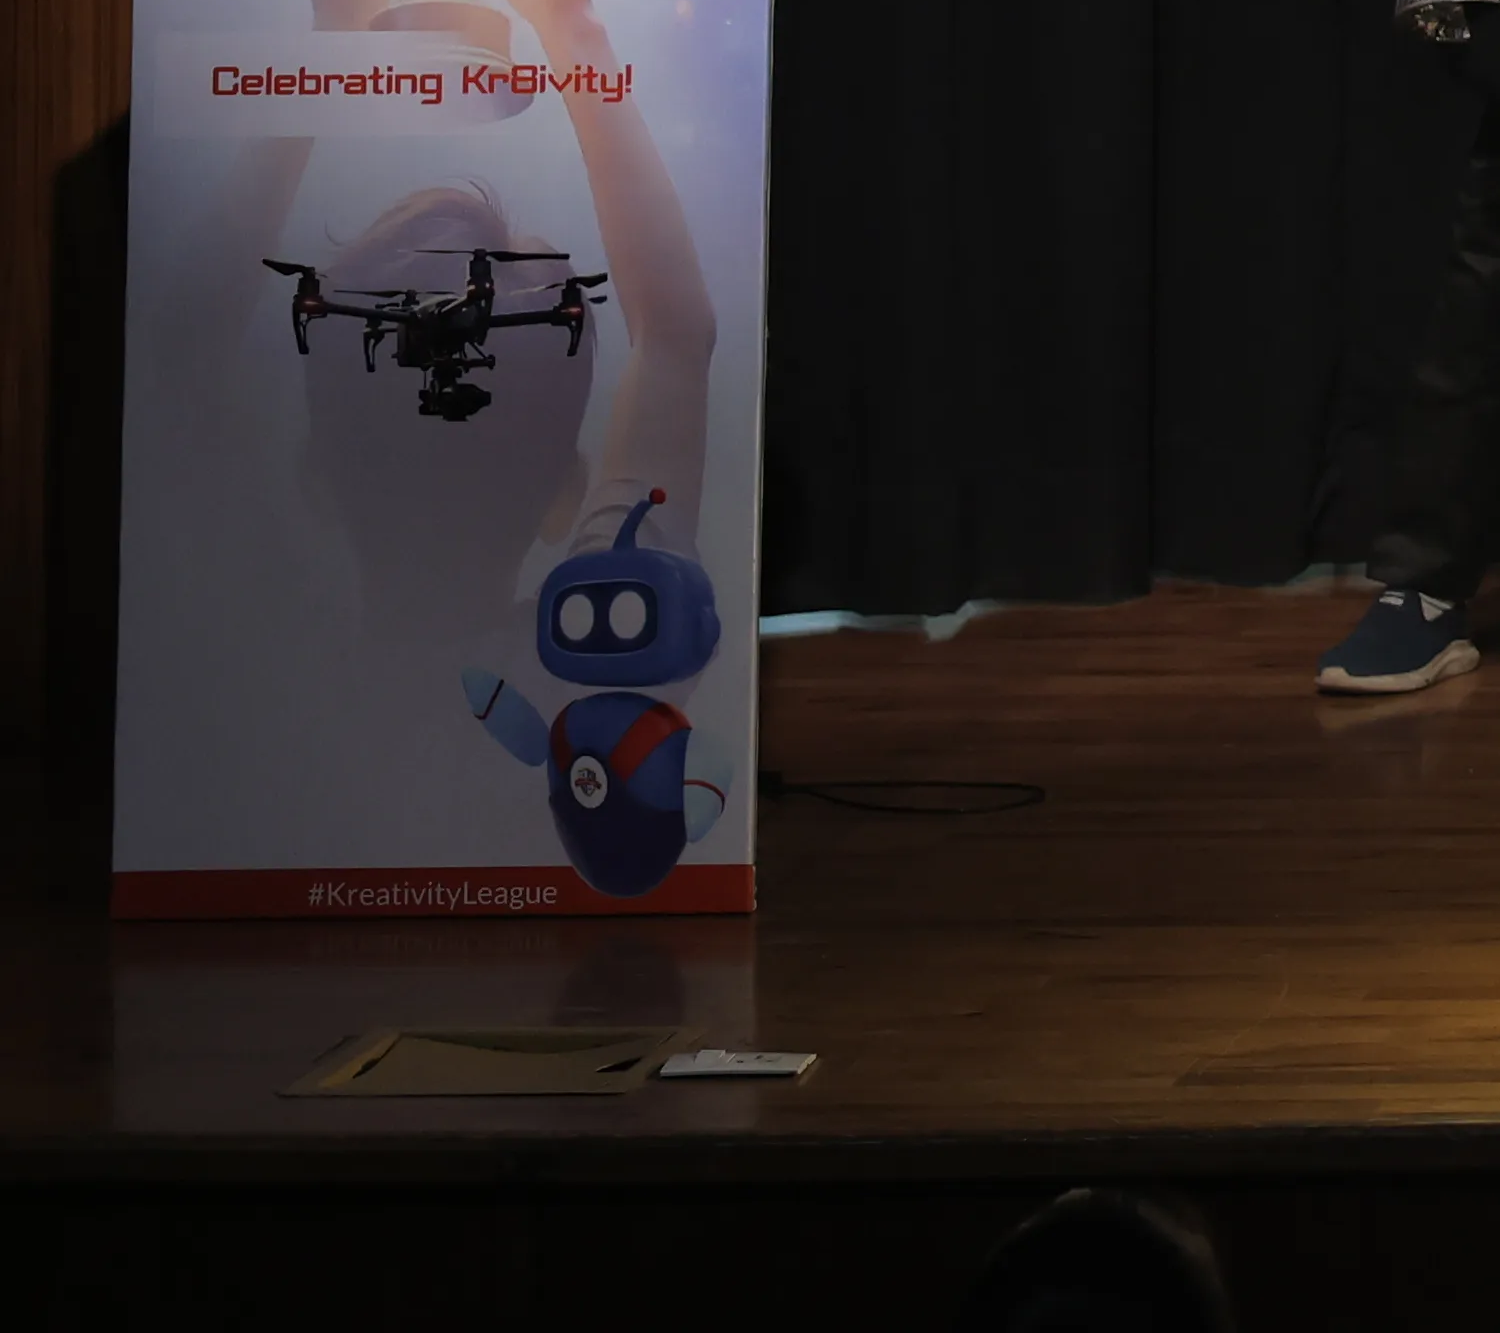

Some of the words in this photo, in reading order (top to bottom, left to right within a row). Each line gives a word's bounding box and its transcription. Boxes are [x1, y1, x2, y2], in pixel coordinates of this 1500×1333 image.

[212, 64, 443, 105] Celebrating
[461, 63, 632, 103] Kr8ivity!
[308, 880, 558, 910] #KreativityLeague
